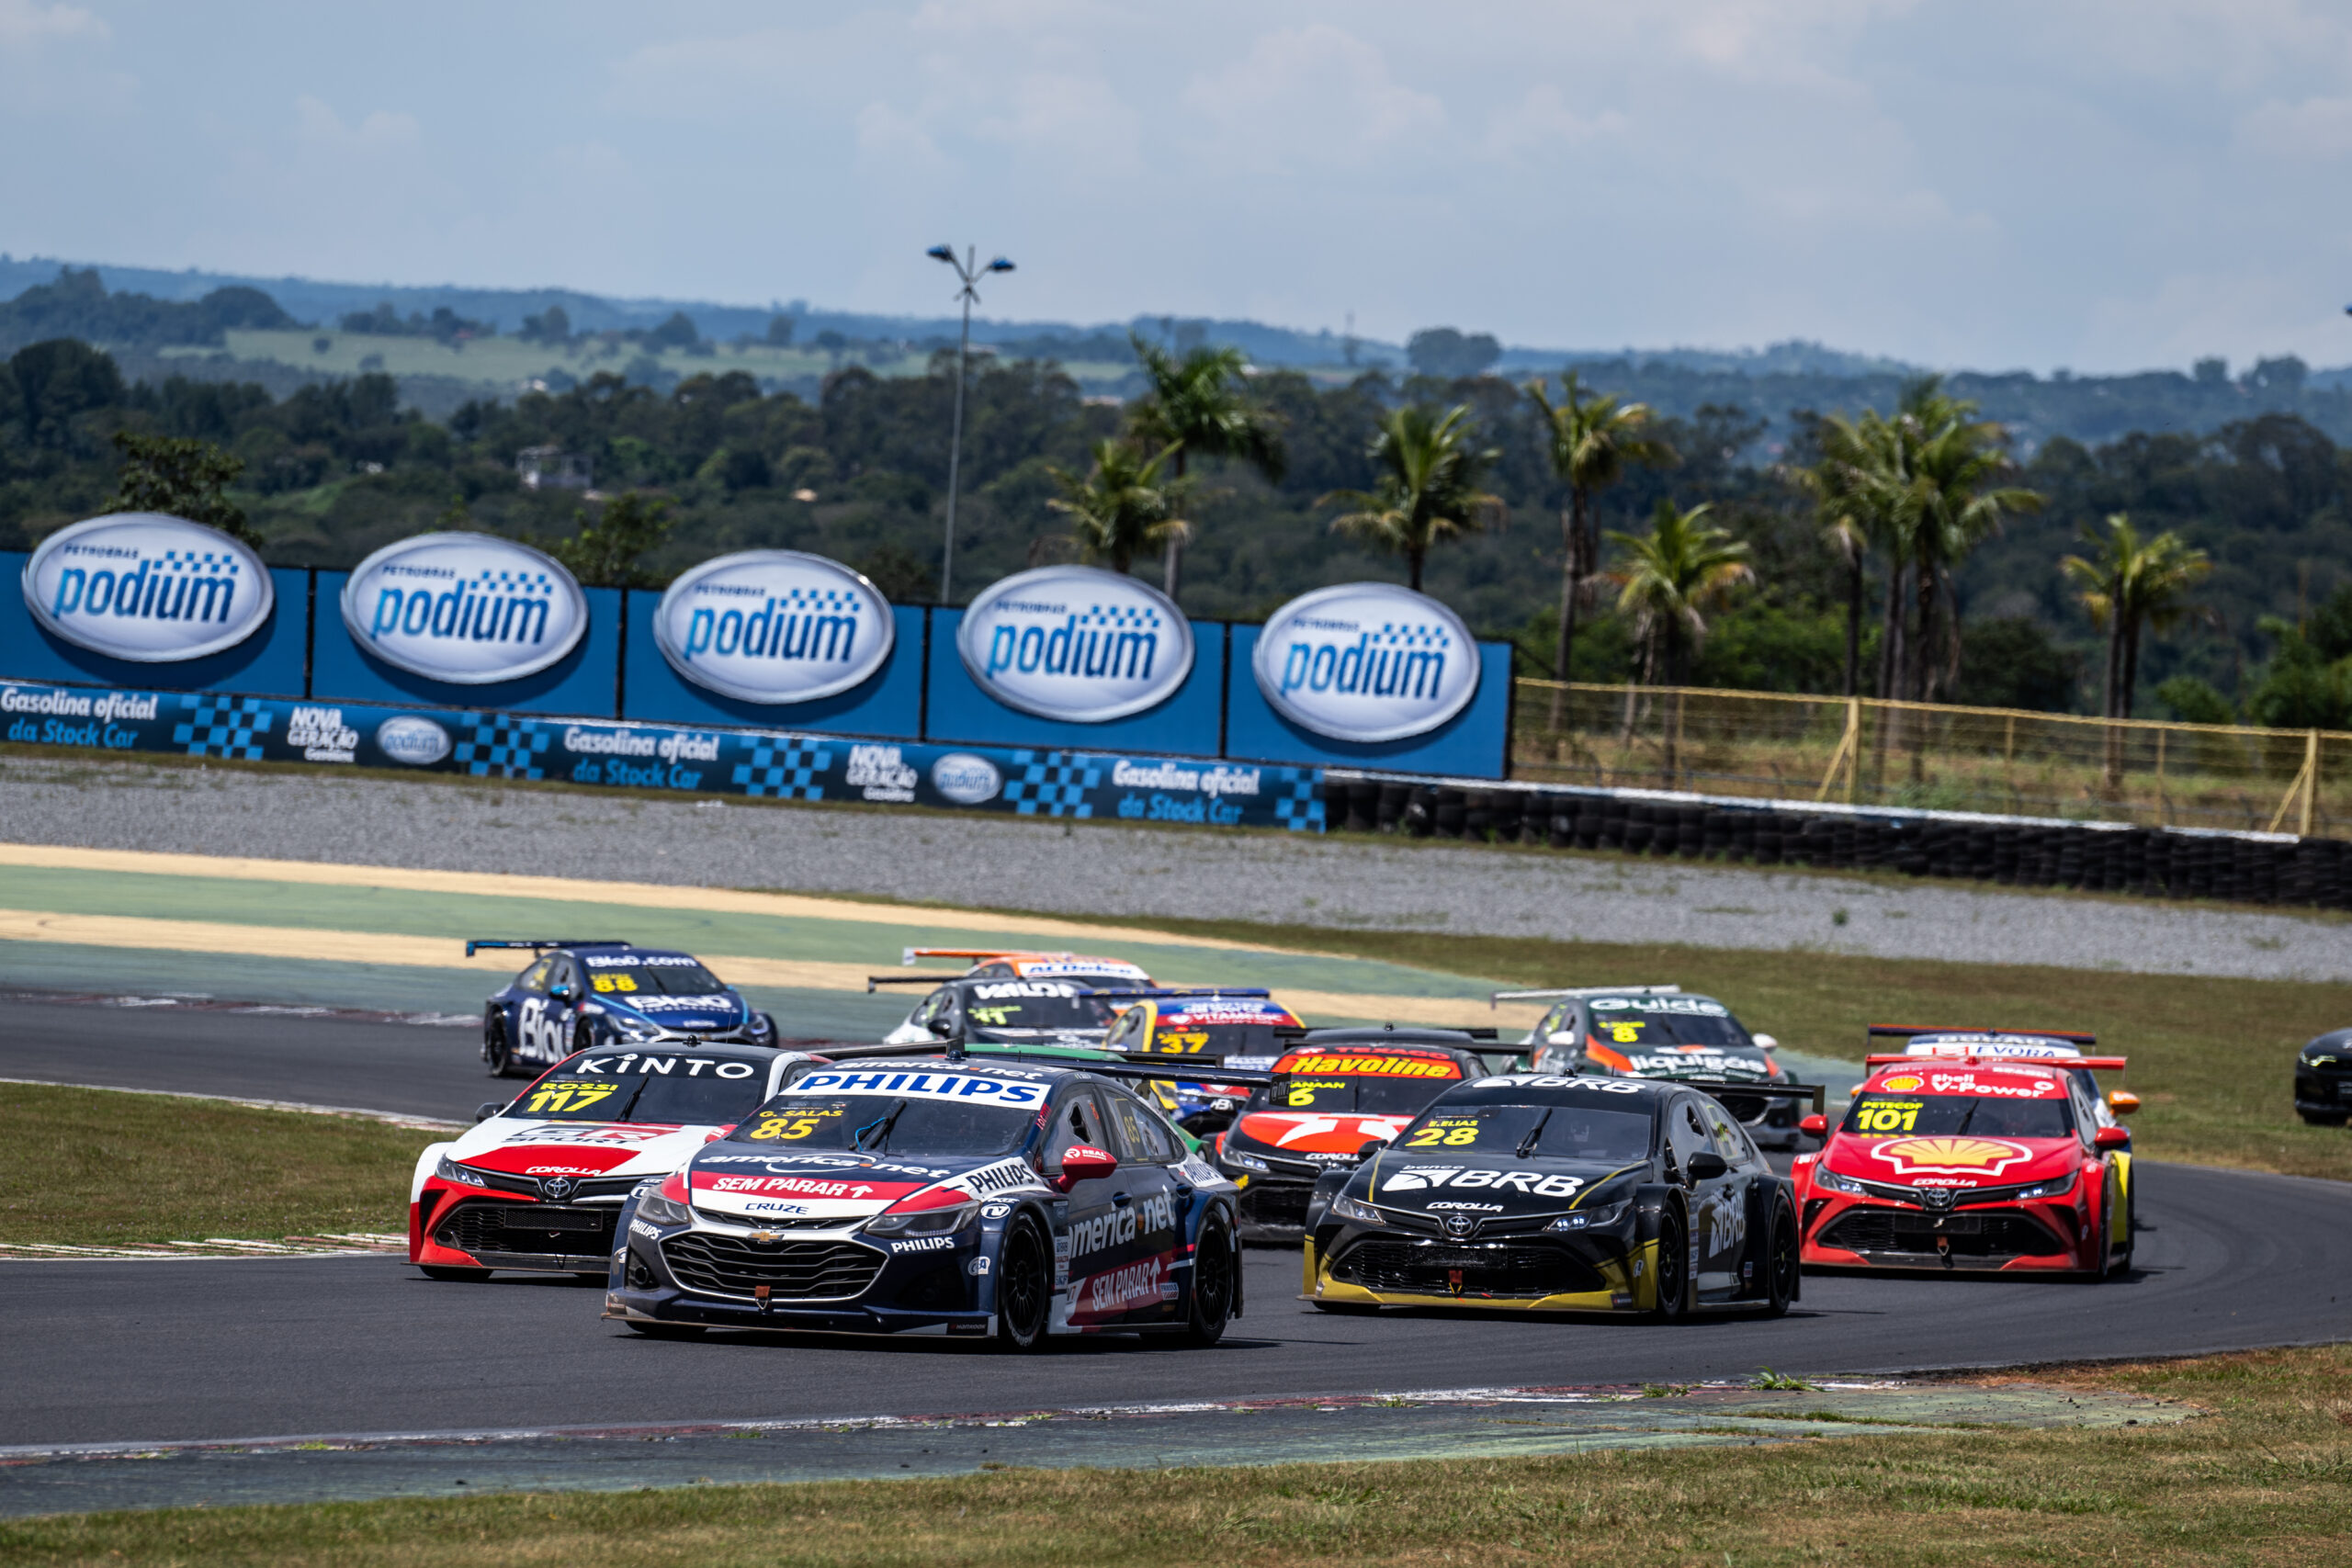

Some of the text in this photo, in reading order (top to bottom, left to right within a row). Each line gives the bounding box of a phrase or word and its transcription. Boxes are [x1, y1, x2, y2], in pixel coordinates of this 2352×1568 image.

[63, 543, 139, 561] PETROBRAS
[382, 564, 456, 581] PETROBRAS
[53, 559, 237, 623] podium
[695, 582, 766, 598] PETROBRAS
[371, 580, 550, 643] podium
[684, 597, 857, 662] podium
[987, 615, 1158, 681] podium
[1281, 631, 1445, 700] podium
[1, 687, 159, 724] Gasolina oficial
[290, 706, 344, 732] NOVA
[8, 717, 139, 749] da Stock Car
[287, 725, 359, 751] GERAÇÃO
[563, 726, 719, 764] Gasolina oficial
[849, 744, 902, 769] NOVA
[573, 758, 703, 790] da Stock Car
[1112, 759, 1261, 798] Gasolina oficial
[1117, 792, 1244, 825] da Stock Car
[594, 979, 638, 993] 88
[1160, 1035, 1209, 1055] 37
[1612, 1026, 1639, 1043] 8
[1334, 1046, 1451, 1060] TEXACO
[576, 1054, 755, 1079] KINTO
[1288, 1056, 1453, 1077] Havoline
[540, 1083, 619, 1091] ROSSI
[797, 1074, 1040, 1102] PHILIPS
[1531, 1077, 1646, 1094] BRB
[1932, 1074, 1974, 1083] Shell
[1289, 1088, 1316, 1106] 6
[1932, 1082, 2045, 1098] V-Power
[526, 1090, 614, 1112] 117
[750, 1118, 820, 1139] 85
[1857, 1109, 1919, 1131] 101
[501, 1136, 640, 1145] SPORT
[1404, 1128, 1479, 1146] 28
[526, 1166, 602, 1176] COROLLA
[966, 1163, 1035, 1194] PHILIPS
[712, 1178, 849, 1196] SEM PARAR
[1449, 1169, 1585, 1197] BRB
[1912, 1178, 1978, 1188] COROLLA
[744, 1202, 809, 1214] CRUZE
[1426, 1201, 1504, 1213] COROLLA
[628, 1218, 662, 1240] PHILIPS
[891, 1236, 956, 1254] PHILIPS
[1091, 1271, 1115, 1312] SEM
[1115, 1262, 1150, 1303] PARAR
